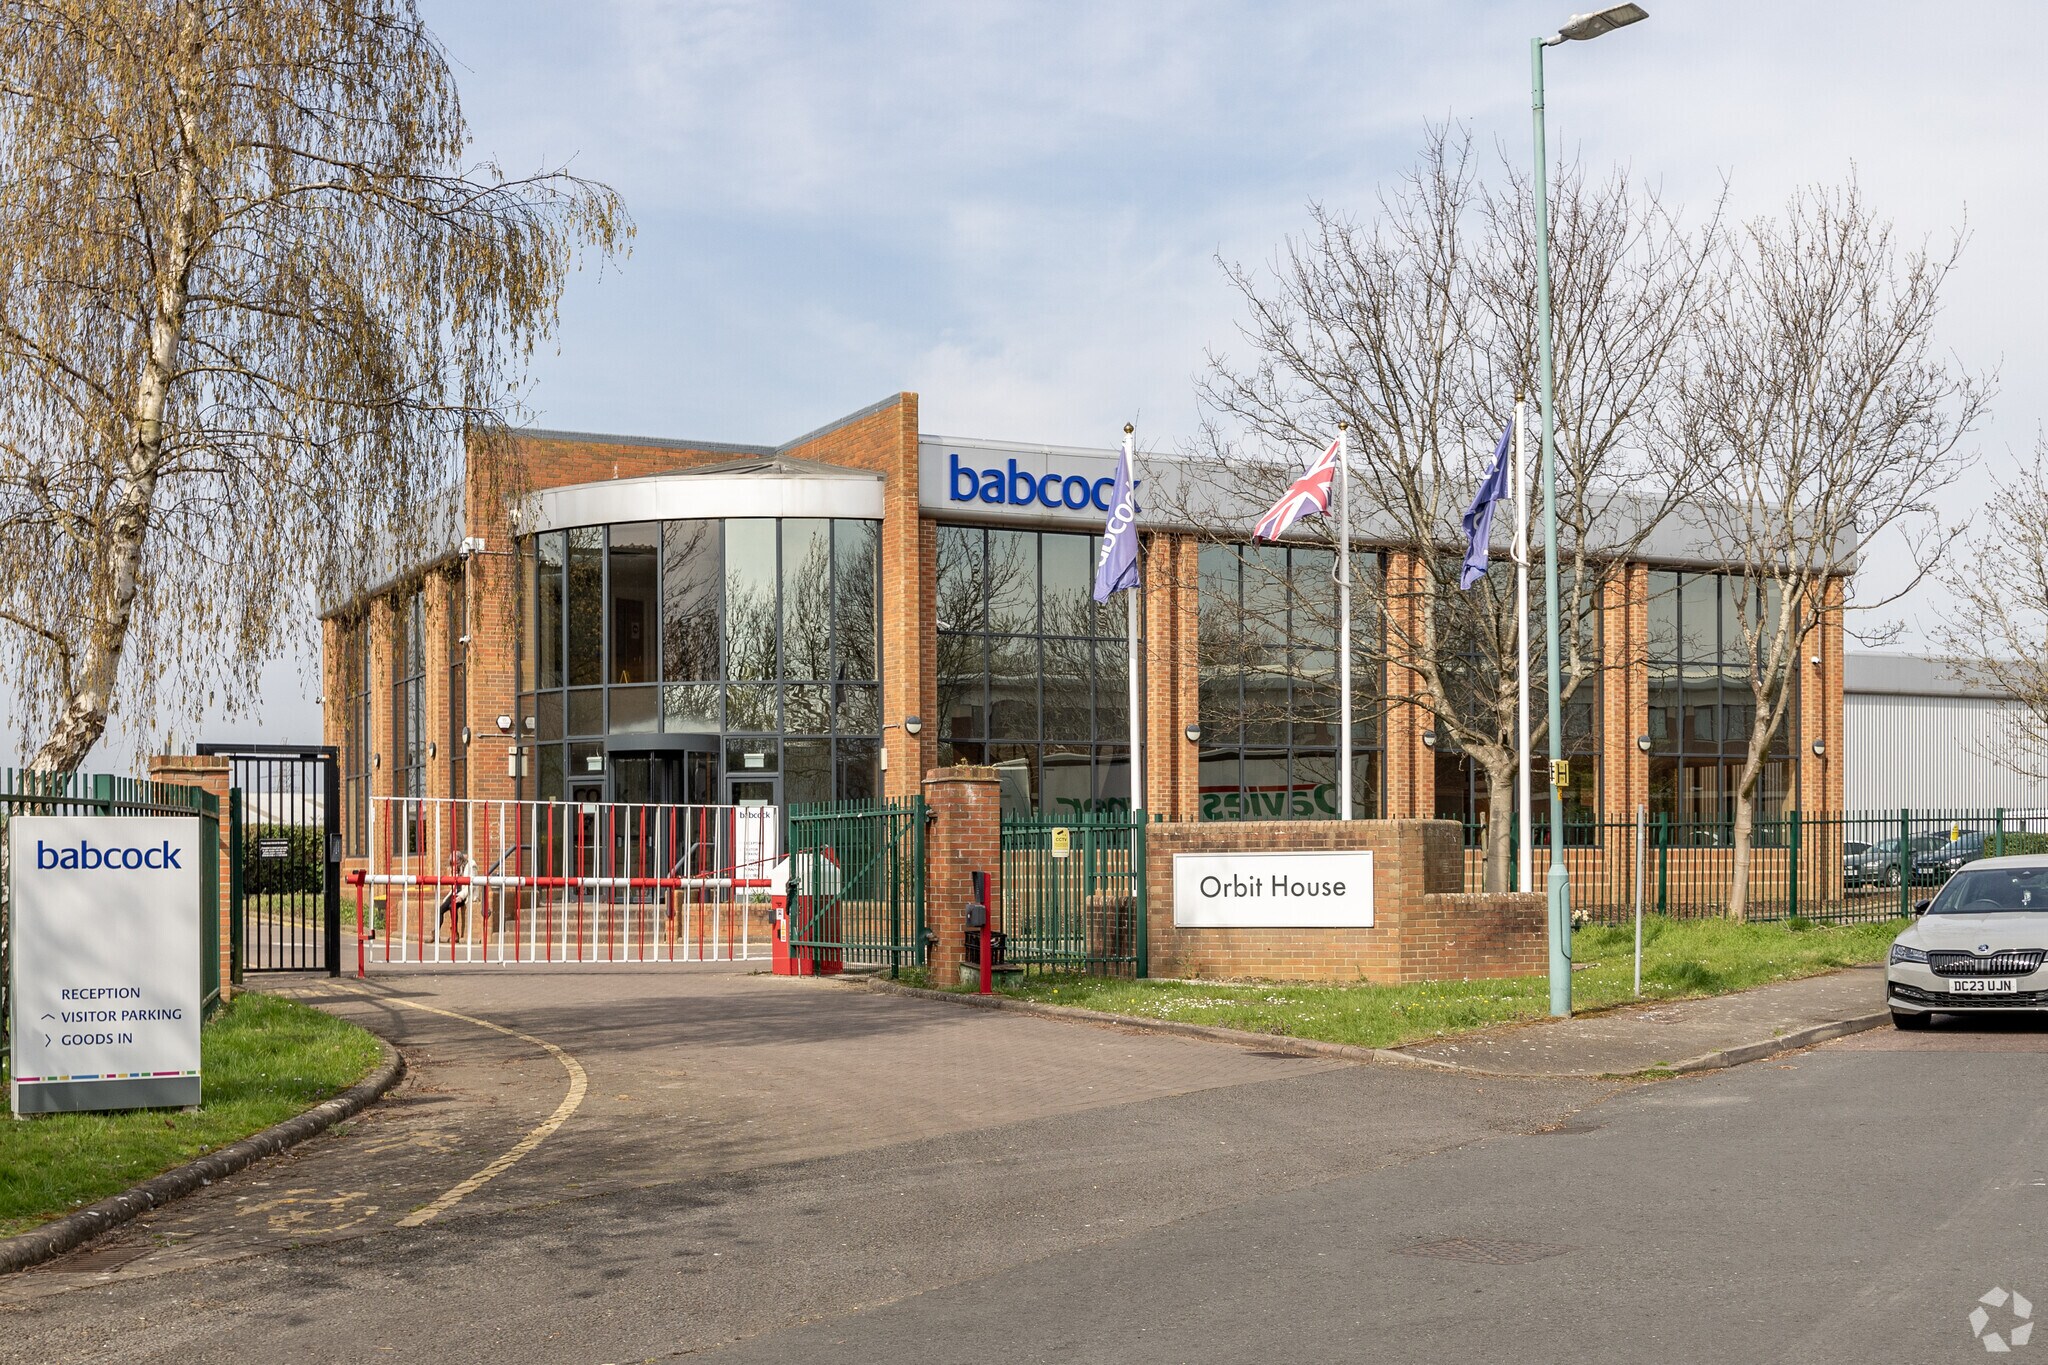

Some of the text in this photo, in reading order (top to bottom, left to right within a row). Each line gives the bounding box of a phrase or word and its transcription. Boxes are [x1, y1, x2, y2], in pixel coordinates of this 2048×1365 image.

[950, 454, 1142, 513] babcoc
[37, 840, 182, 870] babcock
[1200, 874, 1346, 898] Orbit House
[1954, 981, 2011, 991] DC23 UJN
[62, 987, 140, 1000] RECEPTION
[61, 1009, 182, 1023] VISITOR PARKING
[61, 1033, 133, 1046] GOODS IN
